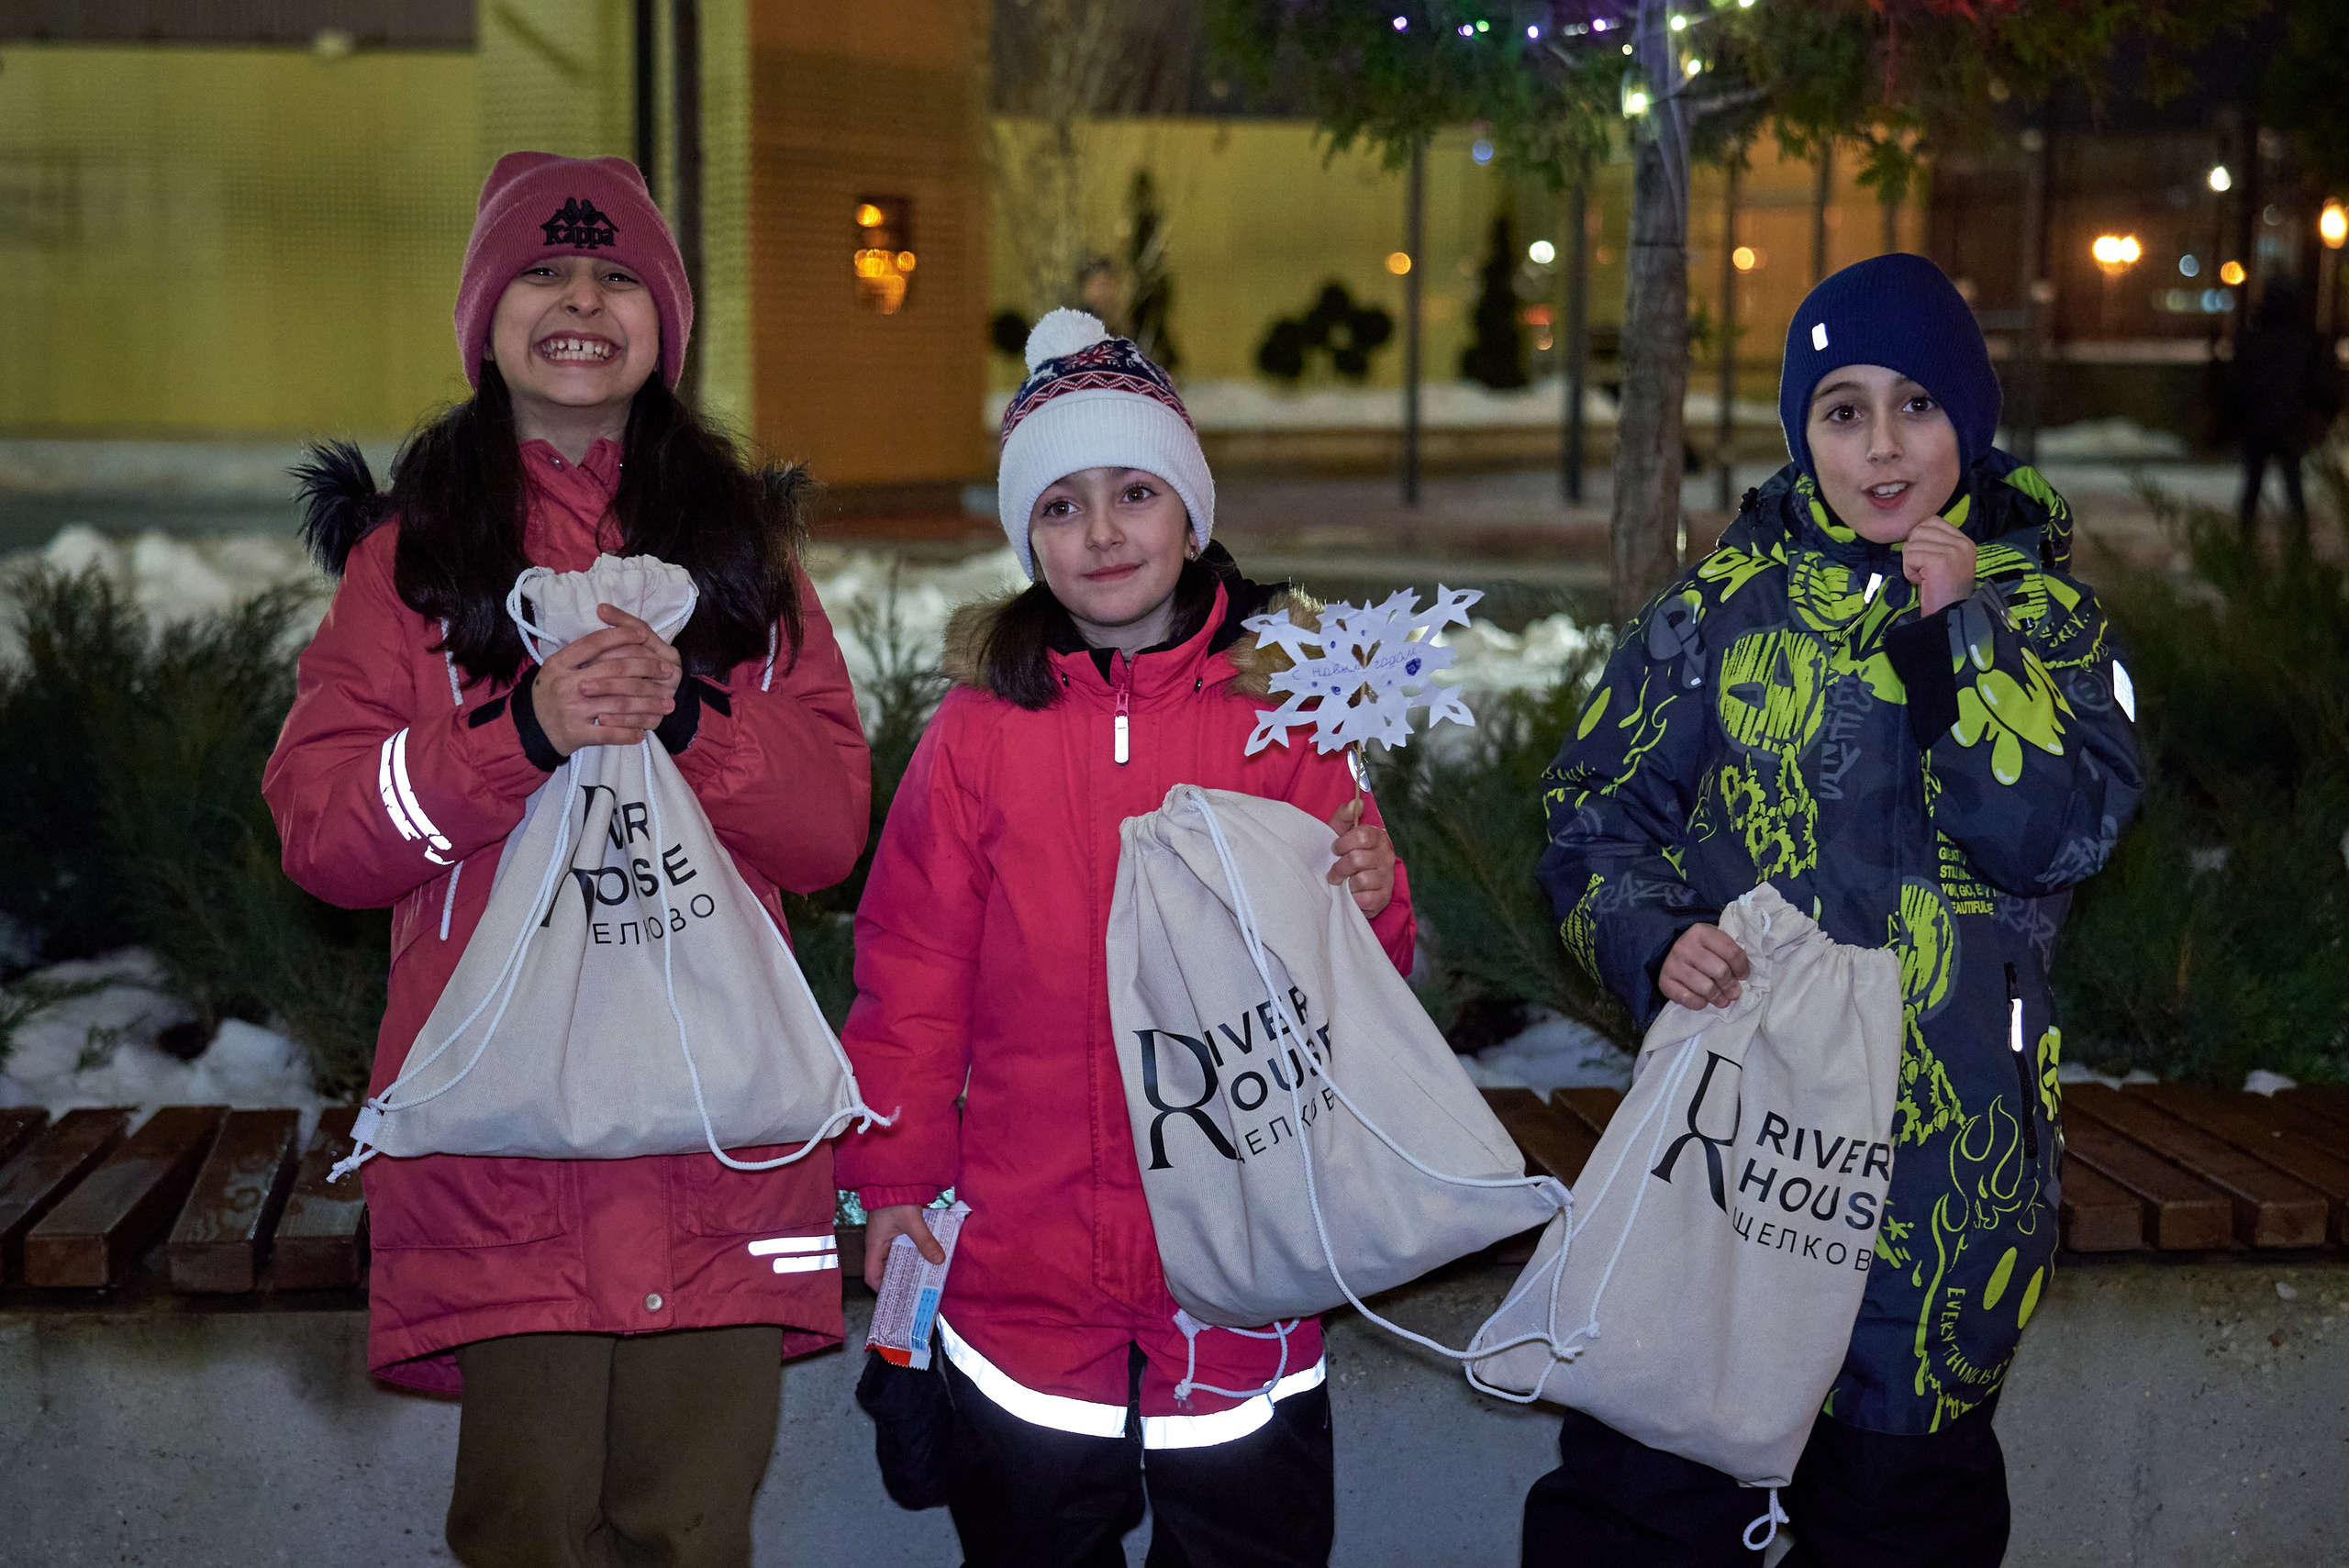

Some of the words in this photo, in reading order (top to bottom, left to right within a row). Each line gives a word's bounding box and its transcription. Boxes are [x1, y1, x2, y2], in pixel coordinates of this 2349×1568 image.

[543, 224, 616, 250] Kappa
[1755, 1110, 1890, 1182] RIVER
[1738, 1158, 1877, 1230] HOUS
[1732, 1207, 1873, 1272] ЩЕЛКОВ
